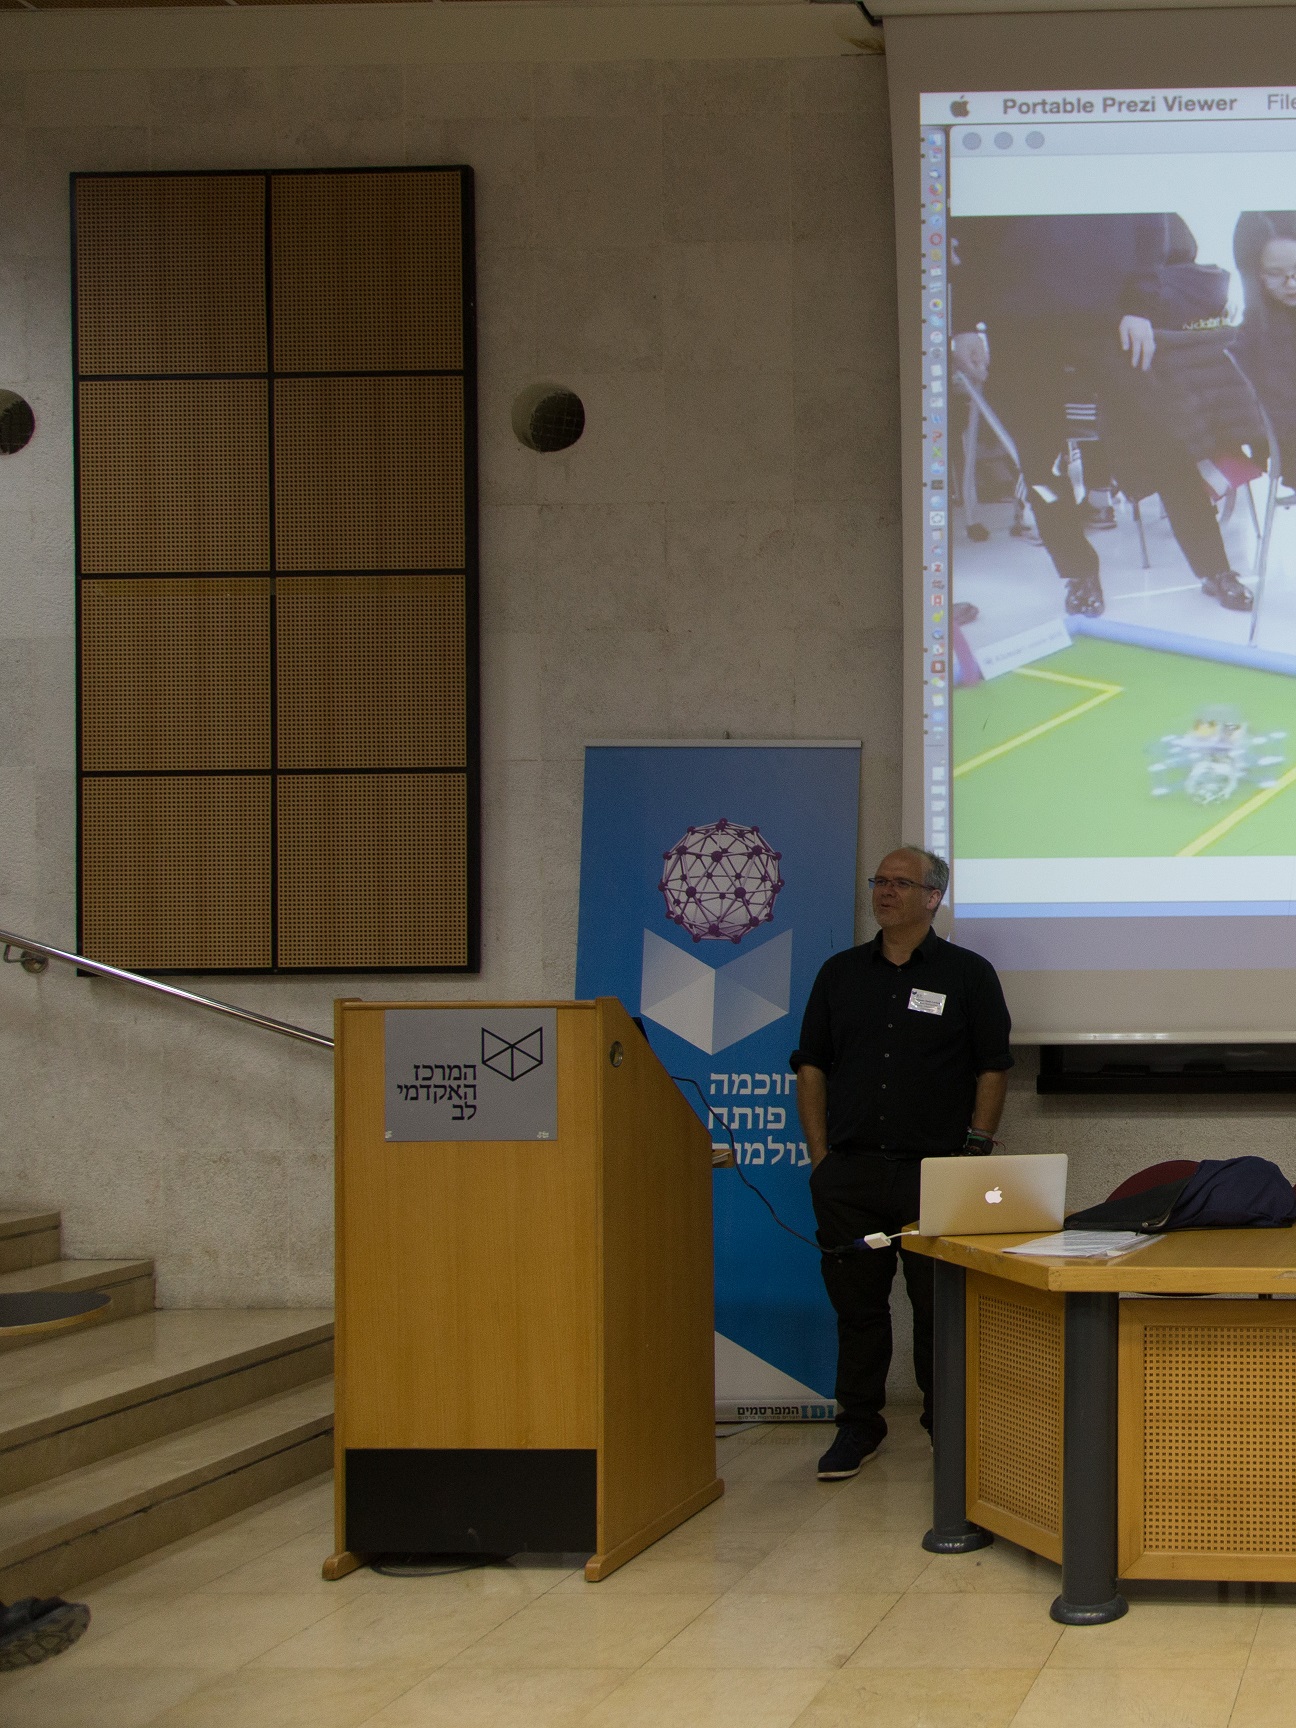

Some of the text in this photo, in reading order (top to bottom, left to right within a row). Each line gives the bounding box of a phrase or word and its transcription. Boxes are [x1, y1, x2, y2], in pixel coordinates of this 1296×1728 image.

[1003, 95, 1237, 115] Portable Prezi Viewer
[413, 1064, 477, 1081] המרכז
[396, 1084, 477, 1105] האקדמי
[451, 1101, 477, 1121] לב
[707, 1105, 787, 1130] פותח
[737, 1406, 800, 1416] המפרסמים
